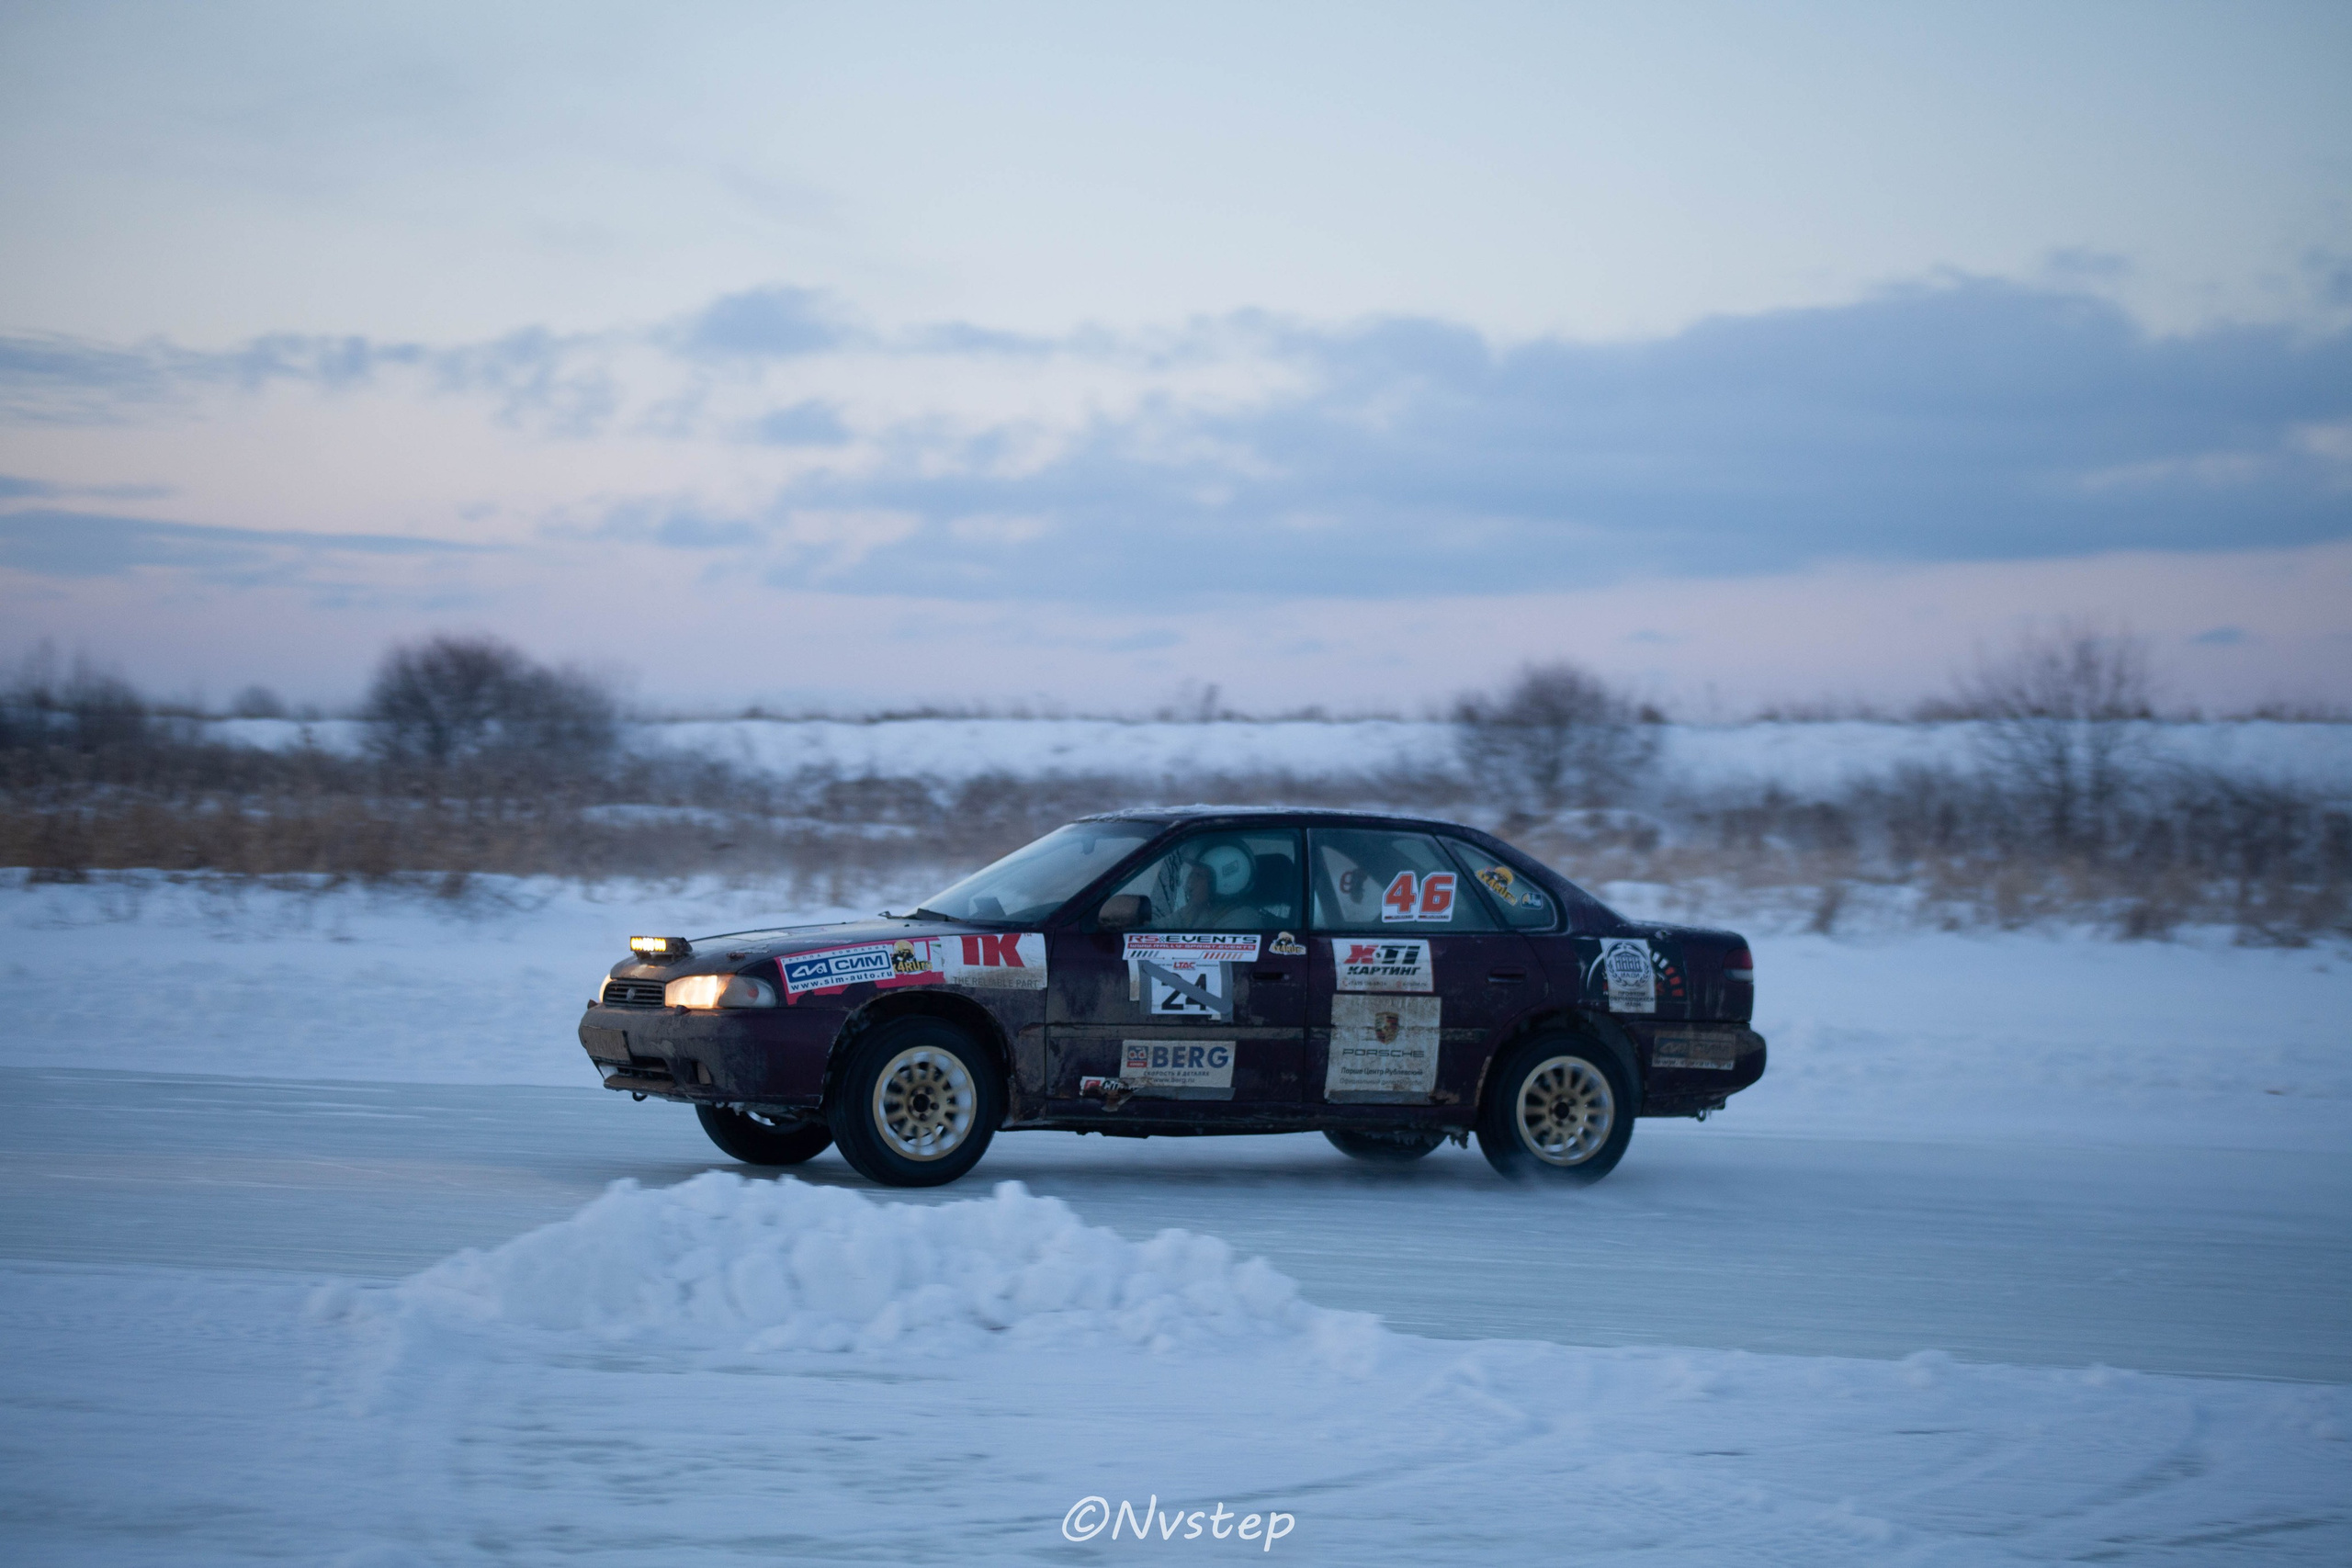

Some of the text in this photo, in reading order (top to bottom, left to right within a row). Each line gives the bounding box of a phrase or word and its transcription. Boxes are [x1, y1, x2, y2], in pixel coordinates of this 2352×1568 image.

[1385, 874, 1454, 913] 46
[1128, 934, 1258, 944] RS EVENTS
[782, 944, 887, 964] ГРУППА КОМПАНИЙ
[834, 955, 885, 970] СИМ
[1347, 965, 1421, 976] КАРТИНГ
[790, 971, 893, 991] www.sim-auto.ru
[953, 976, 1040, 988] THE RELIABLE PART
[1151, 1046, 1229, 1068] BERG
[1342, 1048, 1425, 1057] PORSCHE
[1340, 1066, 1363, 1076] Порше
[1364, 1067, 1385, 1077] Центр
